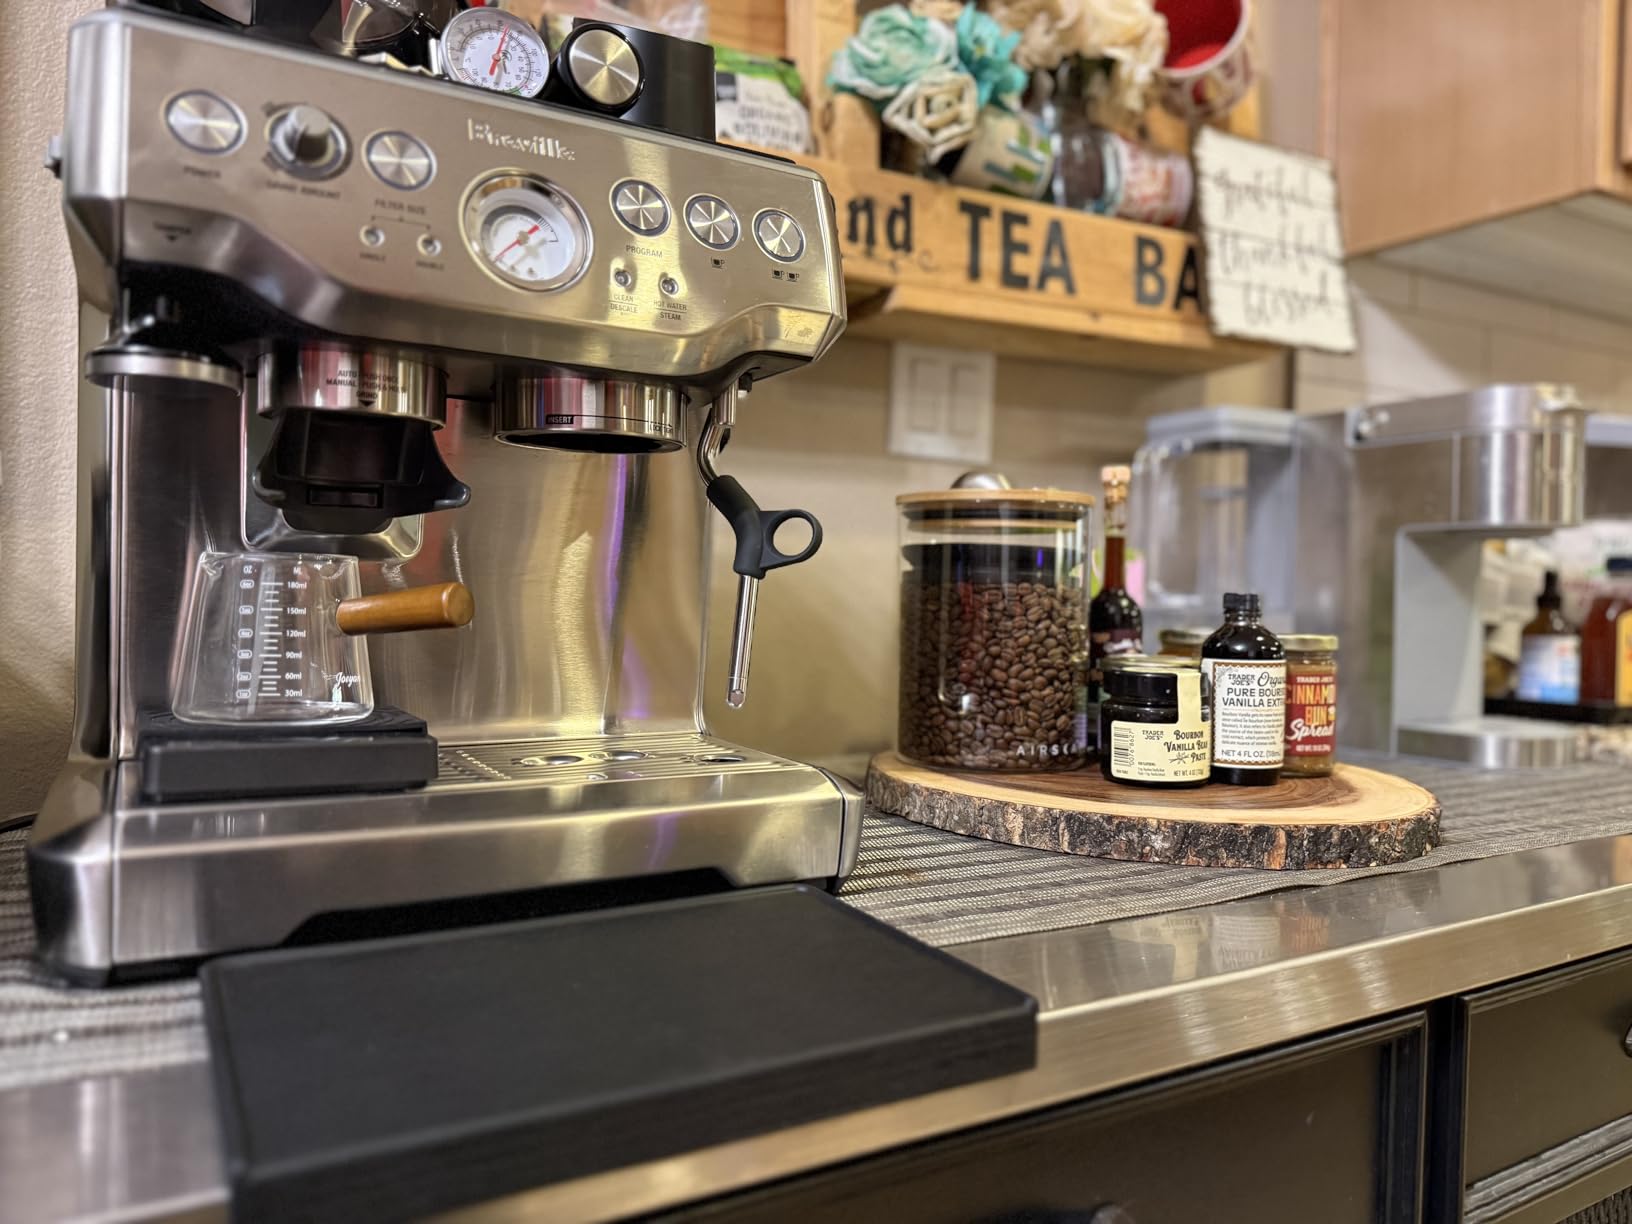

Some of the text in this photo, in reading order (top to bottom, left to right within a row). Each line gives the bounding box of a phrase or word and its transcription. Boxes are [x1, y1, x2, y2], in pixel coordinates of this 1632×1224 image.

[626, 244, 663, 258] PROGRAM
[957, 199, 1076, 296] TEA
[610, 302, 639, 314] DESCALE
[666, 301, 688, 312] WATER
[660, 312, 682, 321] STEAM
[326, 378, 356, 387] MANUAL
[287, 581, 307, 589] 180ml
[286, 630, 306, 638] 120ml
[285, 672, 302, 680] 60ml
[285, 690, 303, 698] 30ml
[1226, 688, 1256, 697] PURE
[1222, 697, 1265, 707] VANILLA
[1305, 706, 1328, 726] BUN
[1286, 718, 1335, 742] Spread
[1163, 740, 1195, 752] VANILLA
